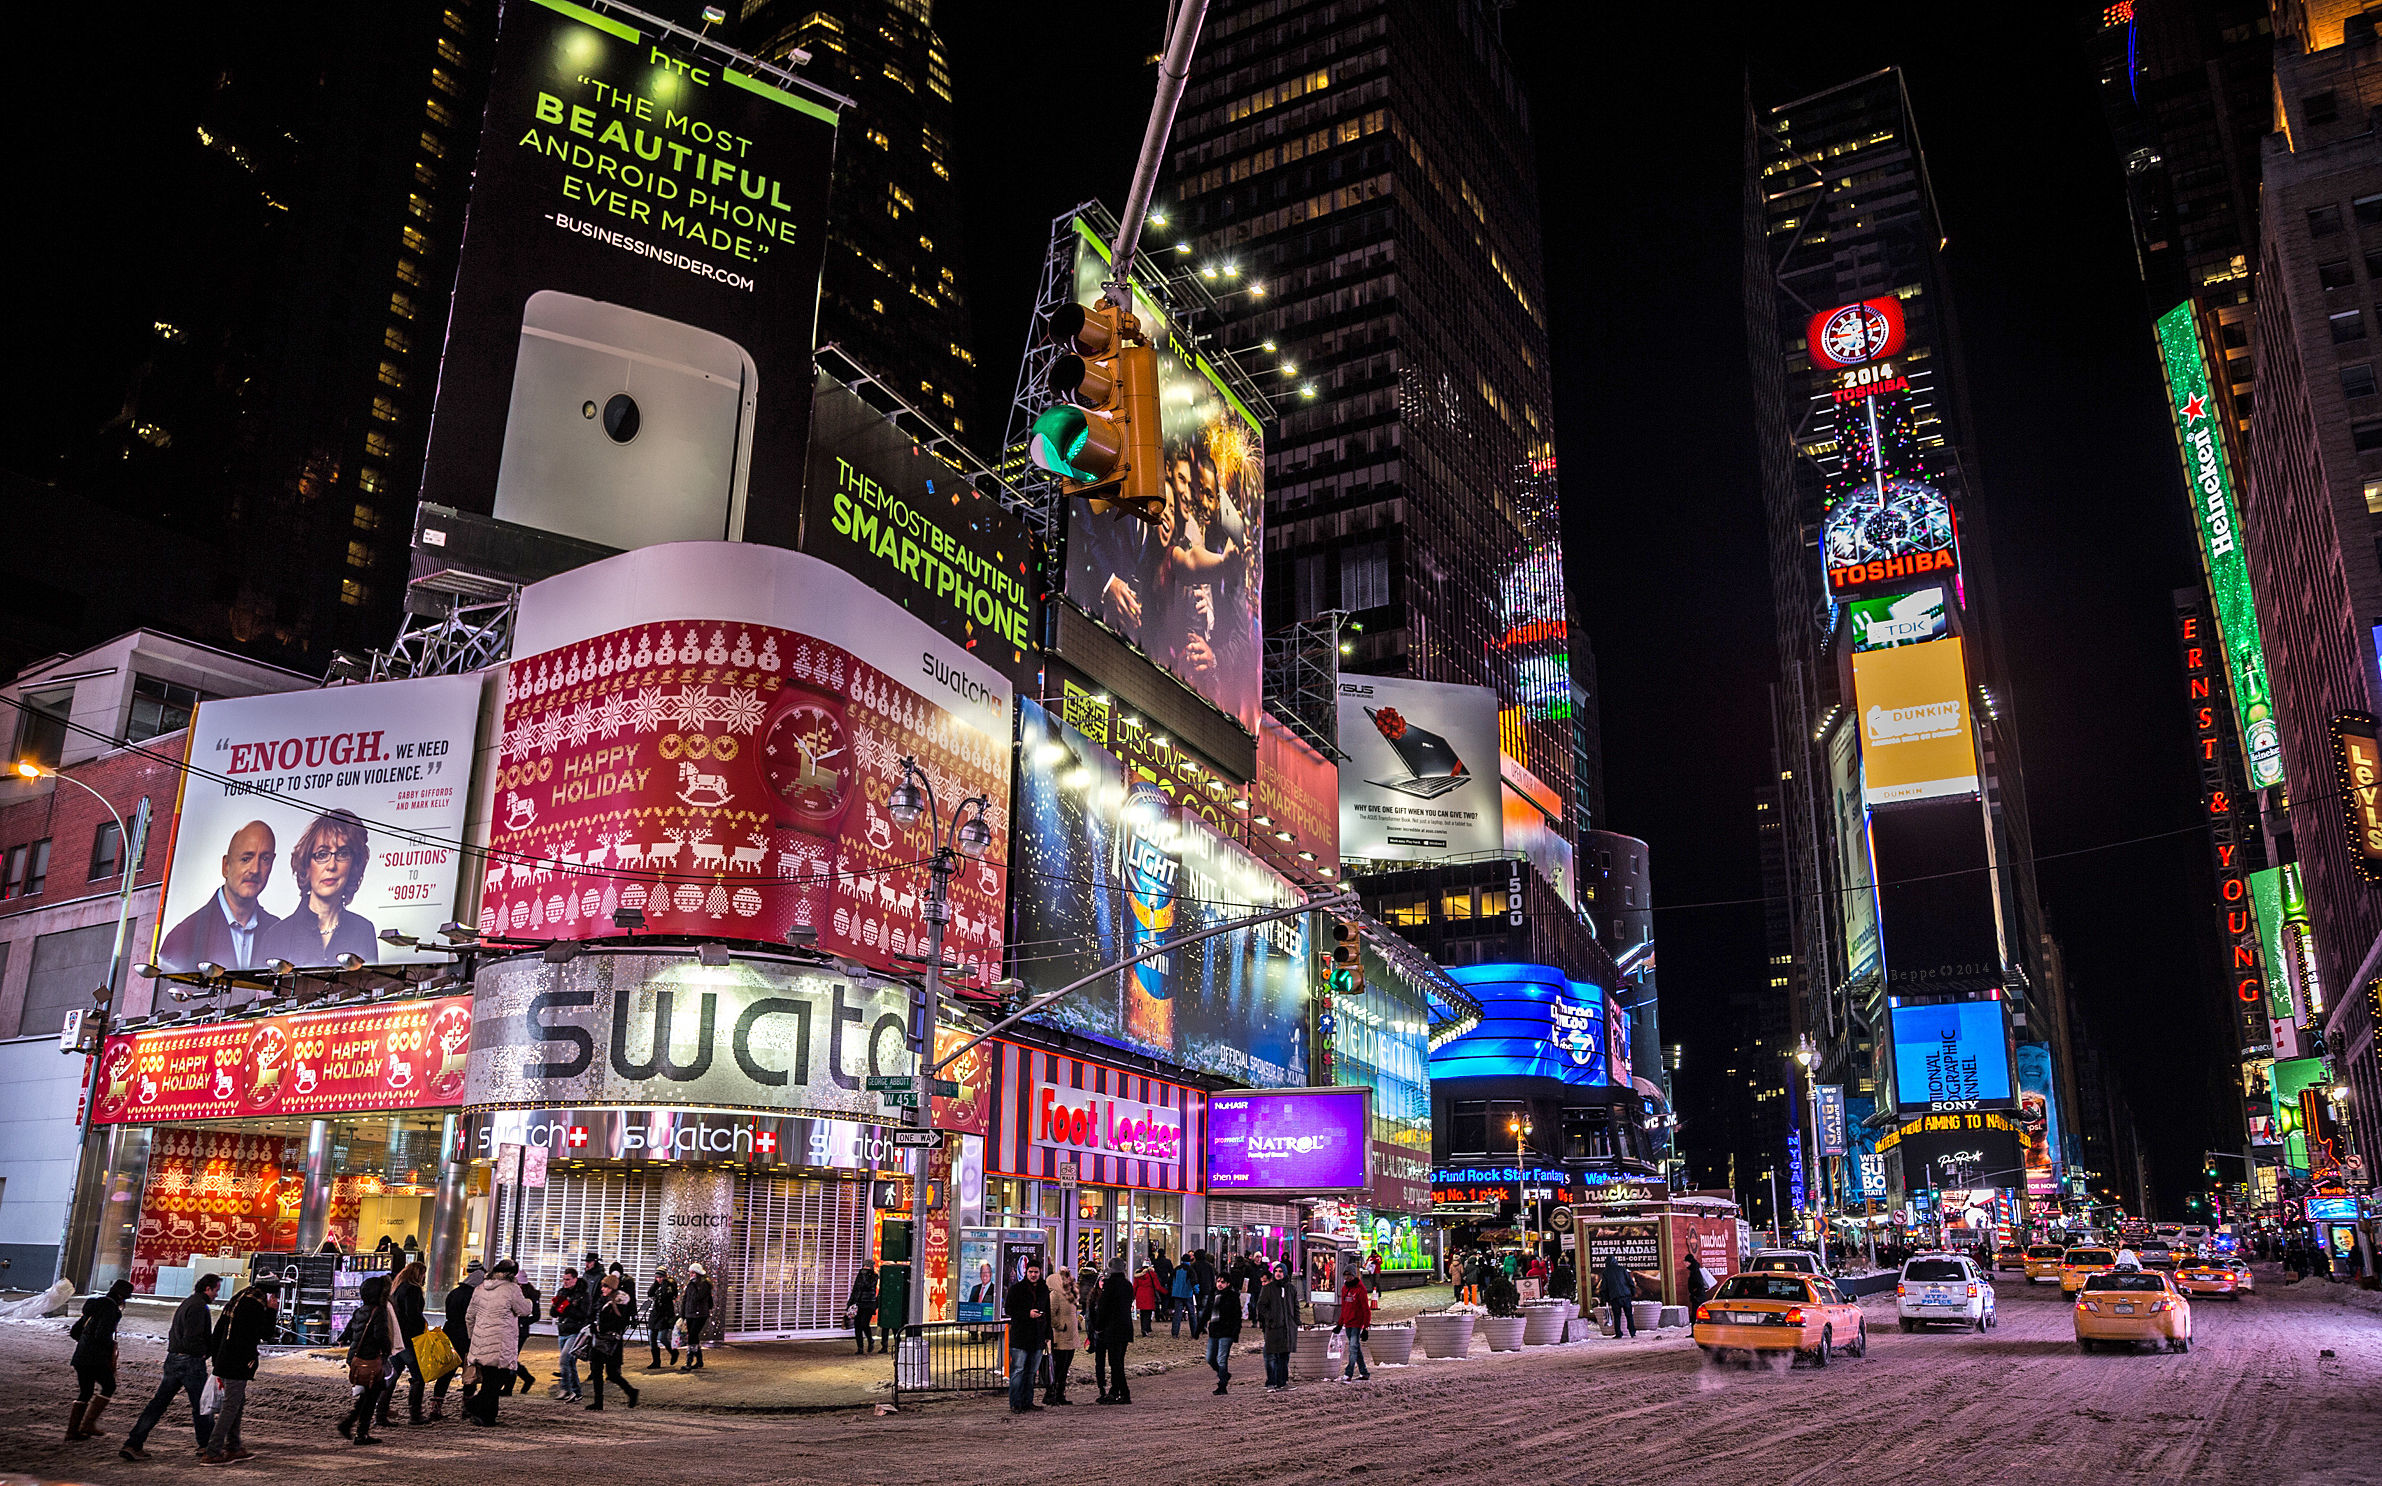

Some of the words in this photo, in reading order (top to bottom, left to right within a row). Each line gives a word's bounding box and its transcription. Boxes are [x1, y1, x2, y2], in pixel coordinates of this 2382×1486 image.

[650, 45, 711, 87] htc
[664, 109, 753, 158] MOST
[535, 91, 792, 212] BEAUTIFUL
[519, 128, 678, 199] ANDROID
[688, 190, 798, 244] PHONE
[562, 175, 650, 225] EVER
[1168, 331, 1194, 370] htc
[1843, 363, 1894, 389] 2014
[1832, 375, 1909, 404] TOSHIBA
[2195, 426, 2234, 560] Heineken
[831, 492, 1028, 651] SMARTPHONE
[1829, 549, 1955, 588] TOSHIBA
[1885, 619, 1926, 637] TDK
[922, 651, 991, 709] swatch
[396, 744, 415, 760] WE
[417, 740, 449, 757] NEED
[563, 742, 640, 780] HAPPY
[223, 780, 254, 797] YOUR
[255, 777, 285, 795] HELP
[287, 776, 302, 791] TO
[304, 773, 333, 790] STOP
[336, 770, 361, 787] GUN
[1511, 762, 1523, 783] OPEN
[398, 790, 421, 800] GABBY
[422, 787, 453, 799] GIFFORDS
[551, 767, 651, 808] HOLIDAY
[1884, 788, 1922, 799] DUNKIN
[396, 800, 409, 811] AND
[410, 799, 430, 810] MARK
[430, 798, 451, 809] KELLY
[1259, 781, 1333, 847] SMARTPHONE
[1354, 804, 1367, 812] WHY
[1368, 805, 1381, 813] GIVE
[1408, 808, 1424, 816] WHEN
[1425, 809, 1436, 817] YOU
[1463, 812, 1478, 820] TWO?
[2184, 618, 2217, 761] ERNST
[2218, 845, 2260, 1003] YOUNG
[408, 835, 428, 847] TEXT
[1189, 820, 1218, 864] NOT
[1128, 838, 1179, 886] LIGHT
[408, 869, 419, 881] TO
[1189, 868, 1218, 910] NOT
[1509, 861, 1523, 926] 1500
[331, 1039, 380, 1060] HAPPY
[1220, 1045, 1249, 1069] OFFICIAL
[170, 1055, 209, 1075] HAPPY
[322, 1059, 383, 1080] HOLIDAY
[161, 1073, 211, 1092] HOLIDAY
[867, 1078, 888, 1086] GEORGE
[889, 1077, 910, 1086] ABBOTT
[885, 1094, 894, 1105] W
[897, 1093, 909, 1105] 45
[1932, 1101, 1980, 1111] SONY
[1038, 1087, 1098, 1147] Foot
[1104, 1099, 1181, 1159] Locker
[1965, 1115, 1981, 1129] TO
[623, 1122, 753, 1153] swatch
[808, 1133, 894, 1163] swatch
[900, 1133, 914, 1142] ONE
[920, 1132, 936, 1142] WAY
[1248, 1135, 1324, 1153] NATROL
[1860, 1154, 1884, 1162] WE'R
[1440, 1170, 1465, 1182] Fund
[1468, 1169, 1501, 1181] Rock
[1447, 1188, 1466, 1201] No.
[1469, 1188, 1475, 1200] 1
[1584, 1185, 1652, 1201] nuchas
[667, 1214, 728, 1227] swatch
[1592, 1246, 1657, 1255] EMPANADAS
